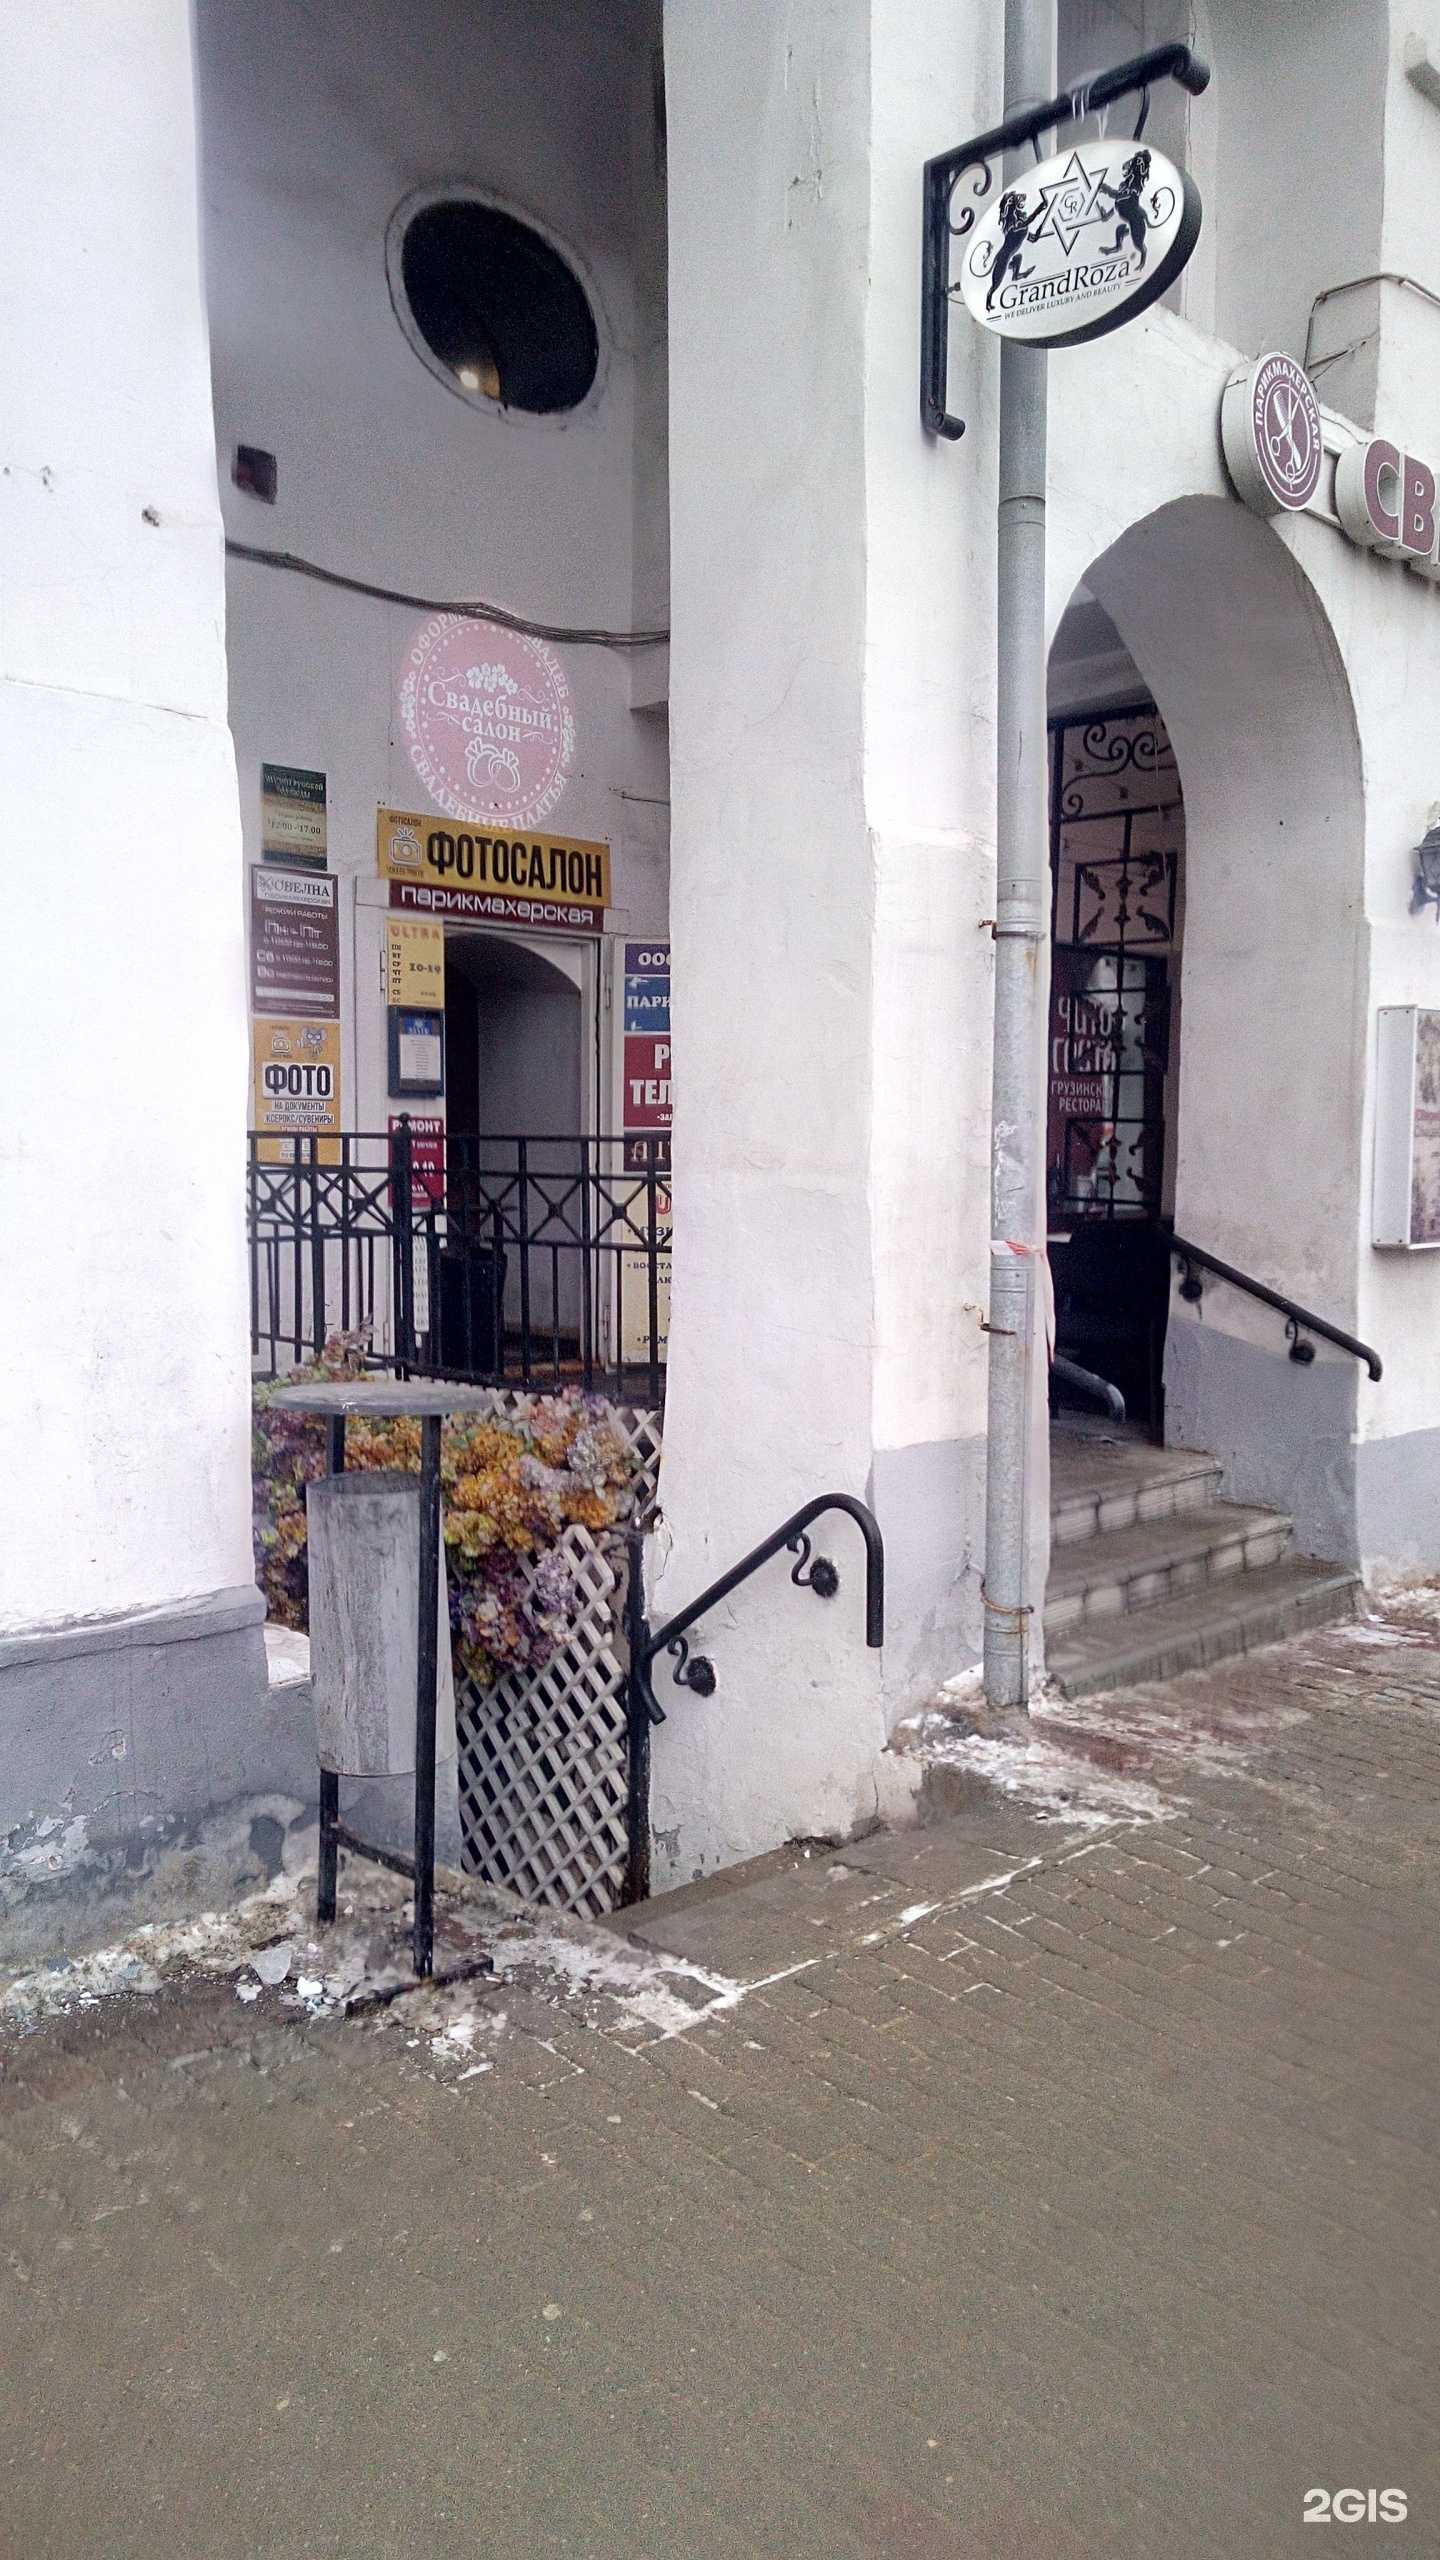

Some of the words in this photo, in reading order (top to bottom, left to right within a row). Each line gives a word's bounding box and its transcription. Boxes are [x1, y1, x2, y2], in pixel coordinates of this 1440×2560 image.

[1000, 260, 1130, 309] GrandRoza
[1004, 310, 1016, 320] WE
[1016, 303, 1046, 317] DELIVER
[1046, 296, 1075, 310] LUXURY
[1075, 290, 1093, 301] AND
[1093, 283, 1121, 297] BEAUTY
[1254, 360, 1320, 451] ПАРИКМАХЕРСКАЯ
[1364, 438, 1440, 562] СВ
[427, 682, 552, 729] Свадебный
[462, 714, 521, 742] салон
[427, 831, 603, 897] ФОТОСАЛОН
[401, 885, 594, 925] парикмахерская
[265, 1064, 331, 1096] ФОТО
[284, 1101, 325, 1112] ДОКУМЕНТЫ
